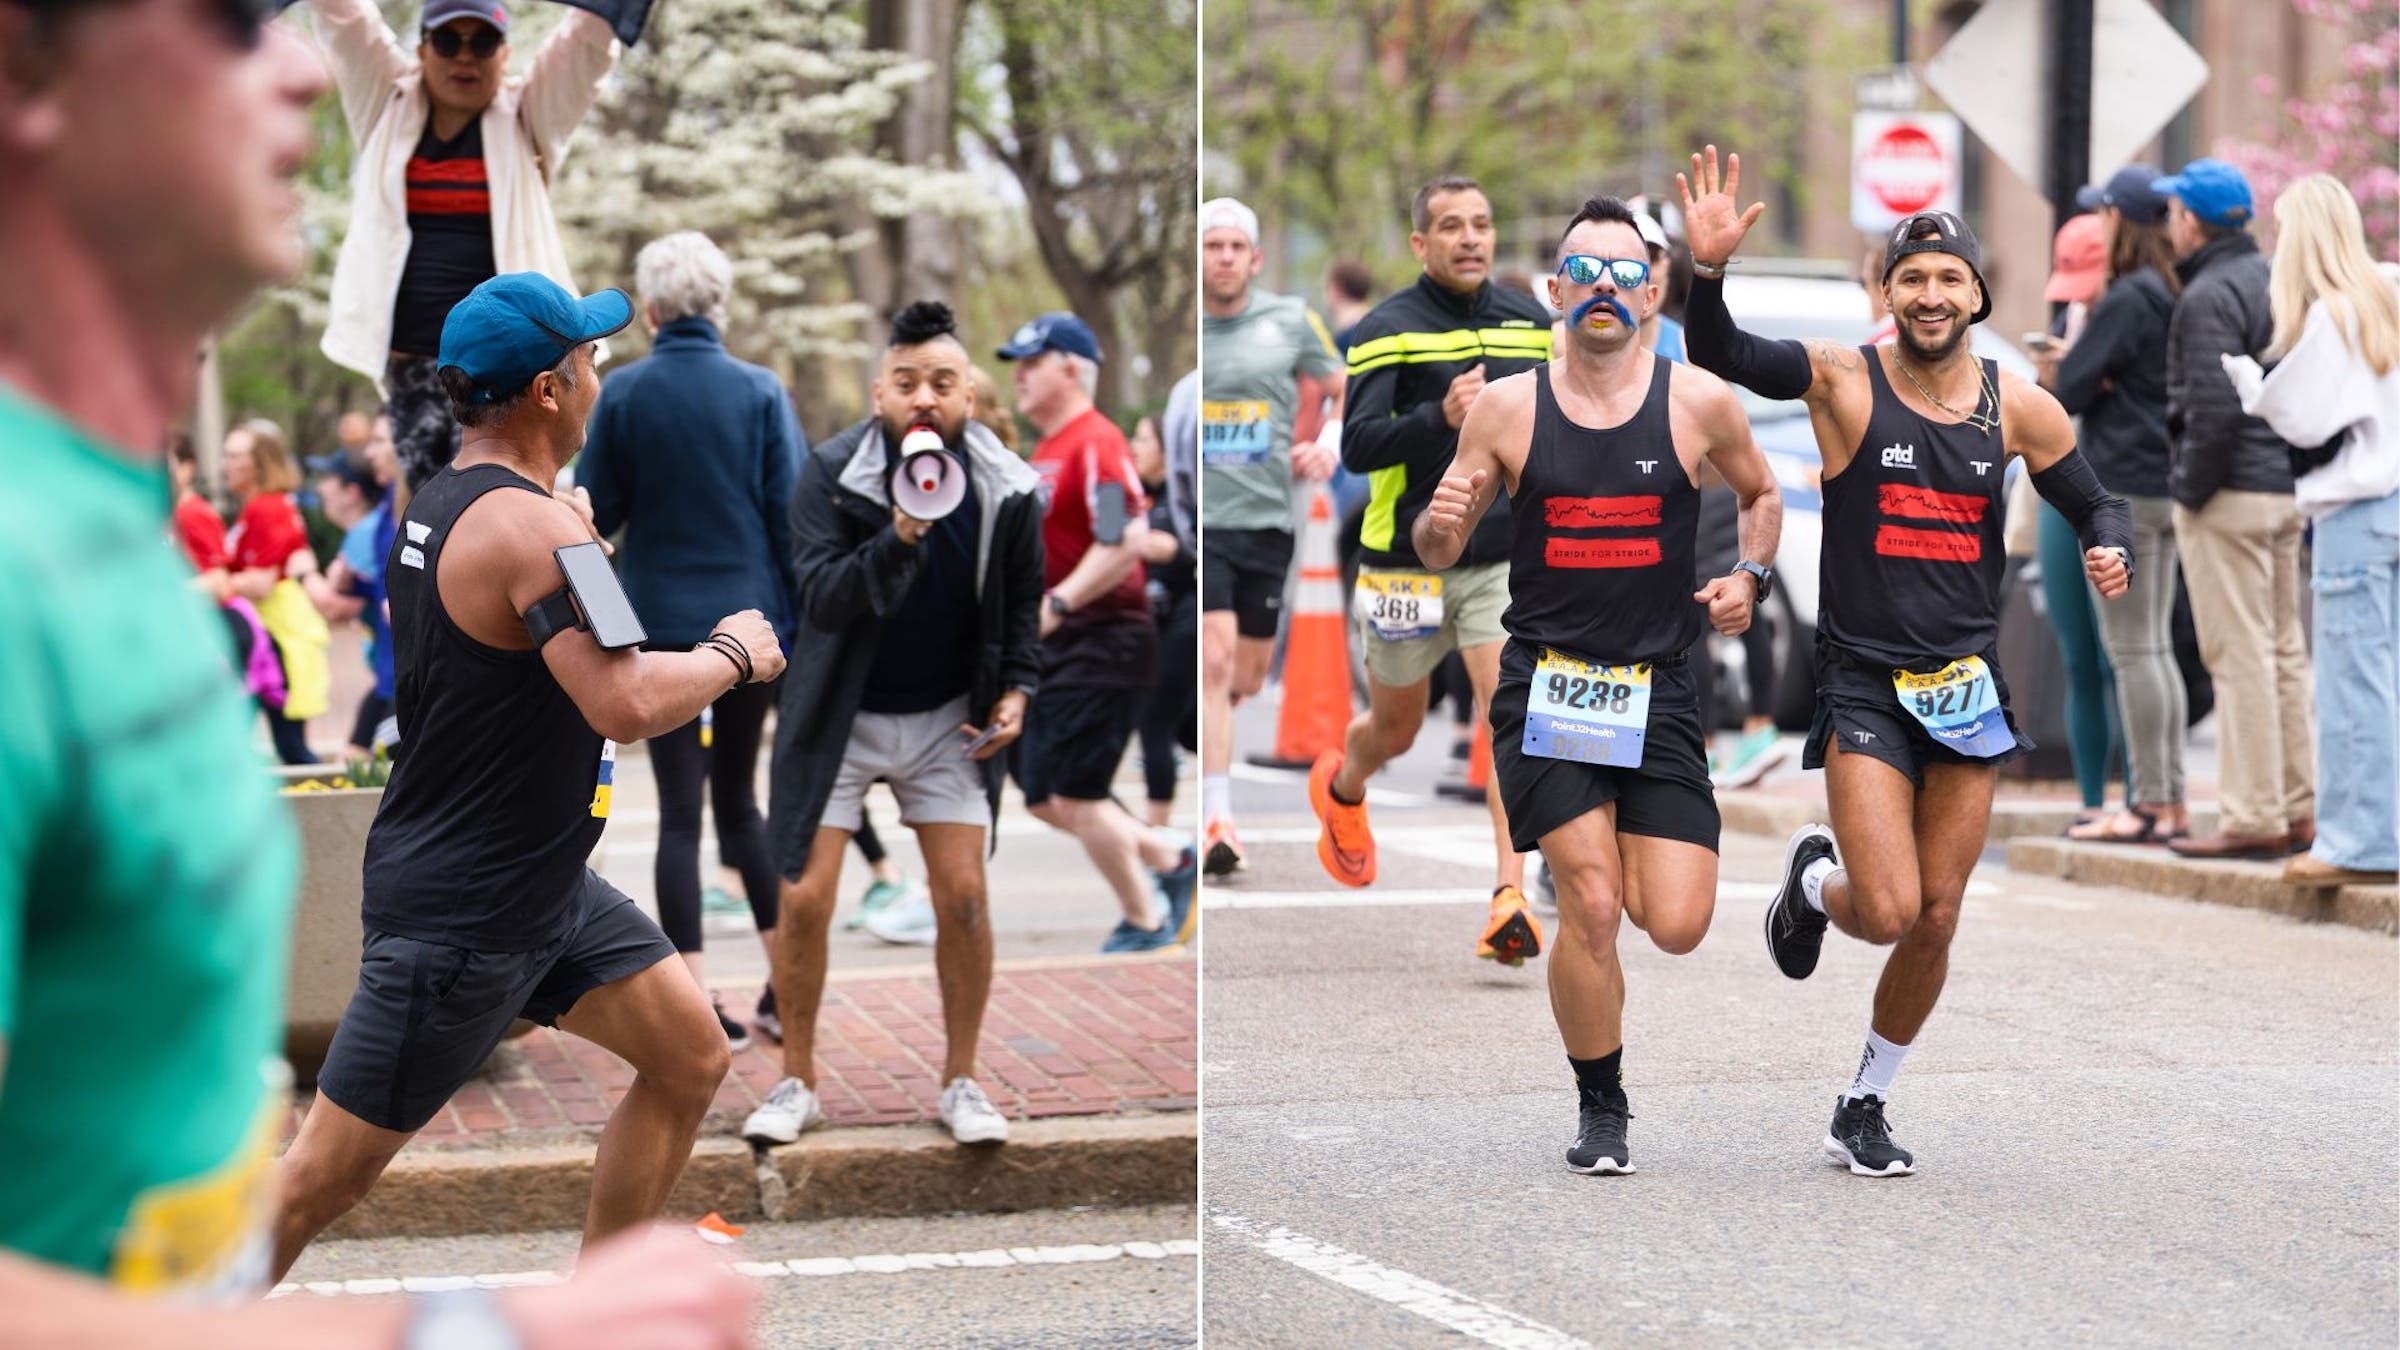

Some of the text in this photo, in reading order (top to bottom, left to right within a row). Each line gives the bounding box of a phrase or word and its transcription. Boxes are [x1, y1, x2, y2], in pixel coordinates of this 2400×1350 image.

[1881, 443, 1914, 467] gtd
[1554, 549, 1650, 558] STRIDE FOR STRIDE
[1373, 596, 1420, 622] 368
[1547, 673, 1632, 715] 9238
[1915, 674, 1985, 718] 9277
[1551, 720, 1616, 738] Point32Health
